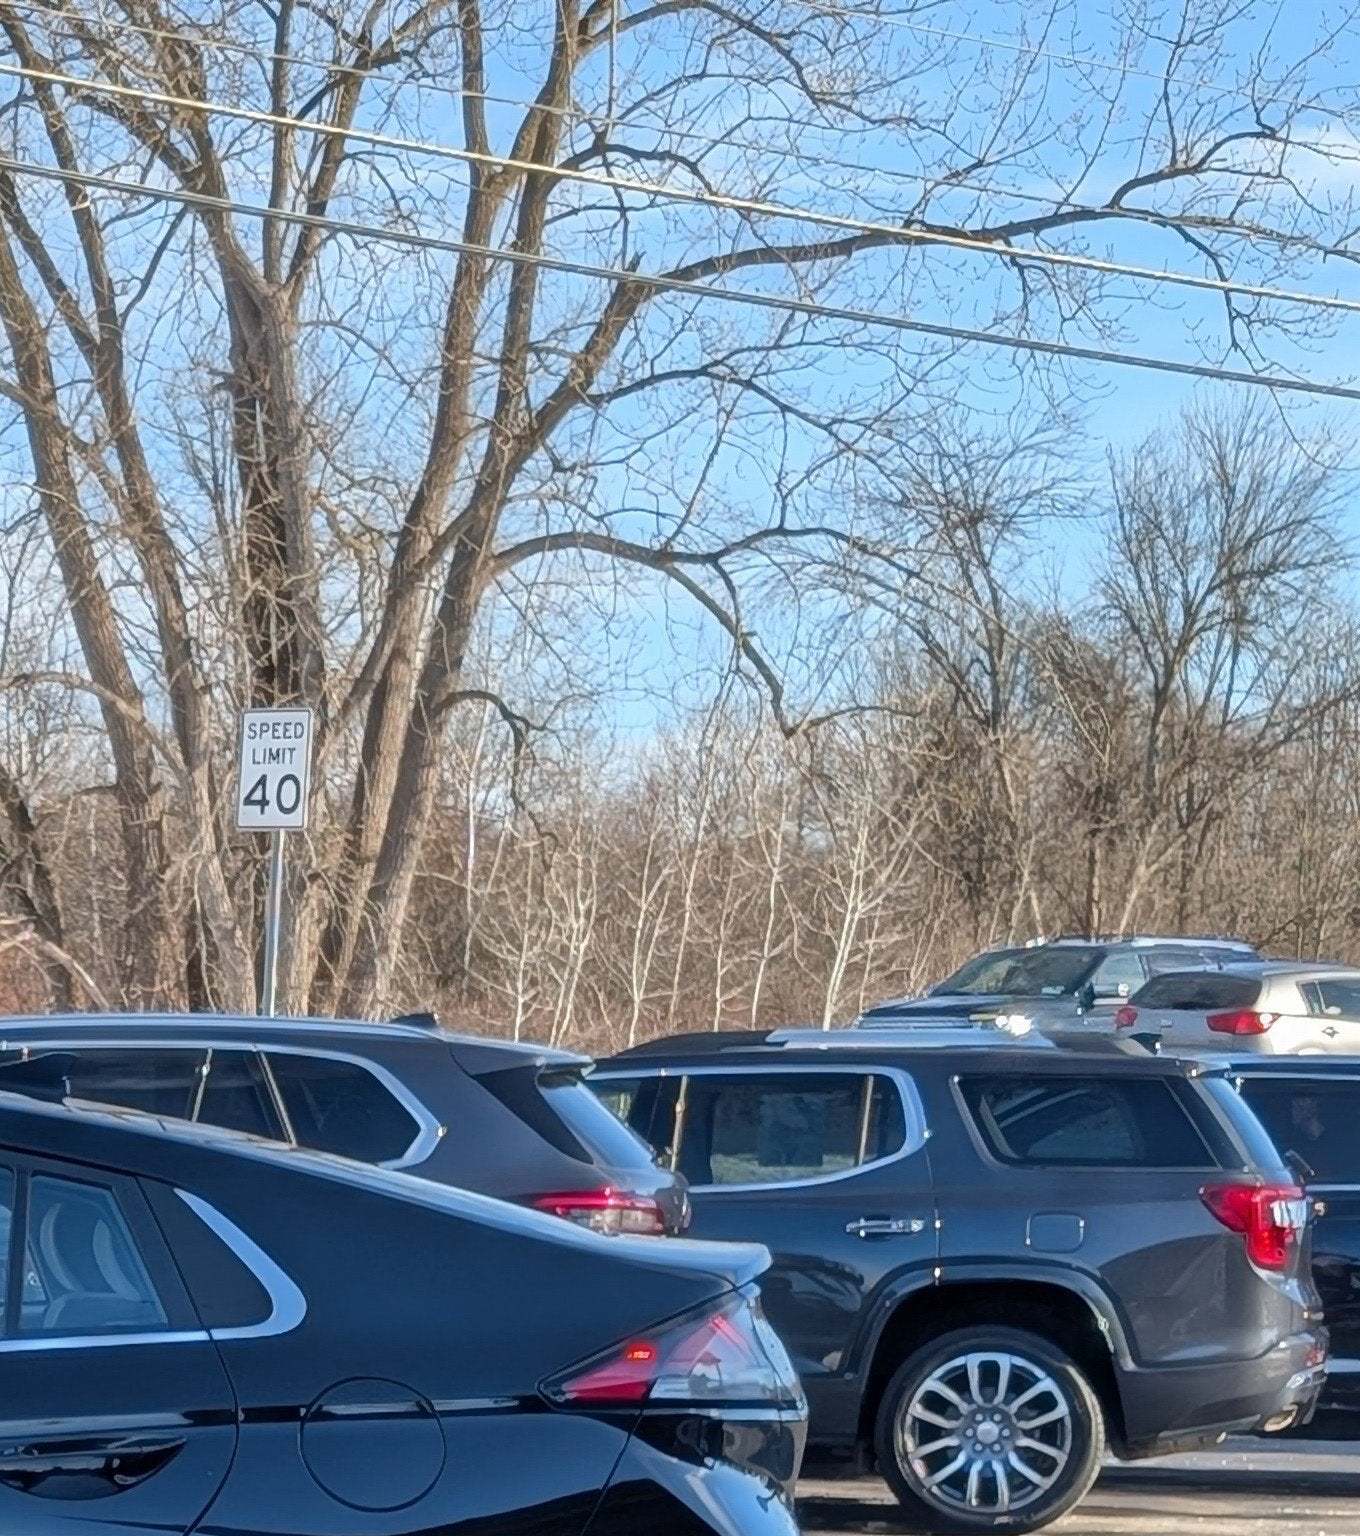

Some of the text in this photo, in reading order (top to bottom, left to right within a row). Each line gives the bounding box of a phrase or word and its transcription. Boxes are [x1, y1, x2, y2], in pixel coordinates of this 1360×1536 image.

[247, 722, 305, 740] SPEED
[252, 747, 296, 765] LIMIT
[243, 774, 301, 815] 40
